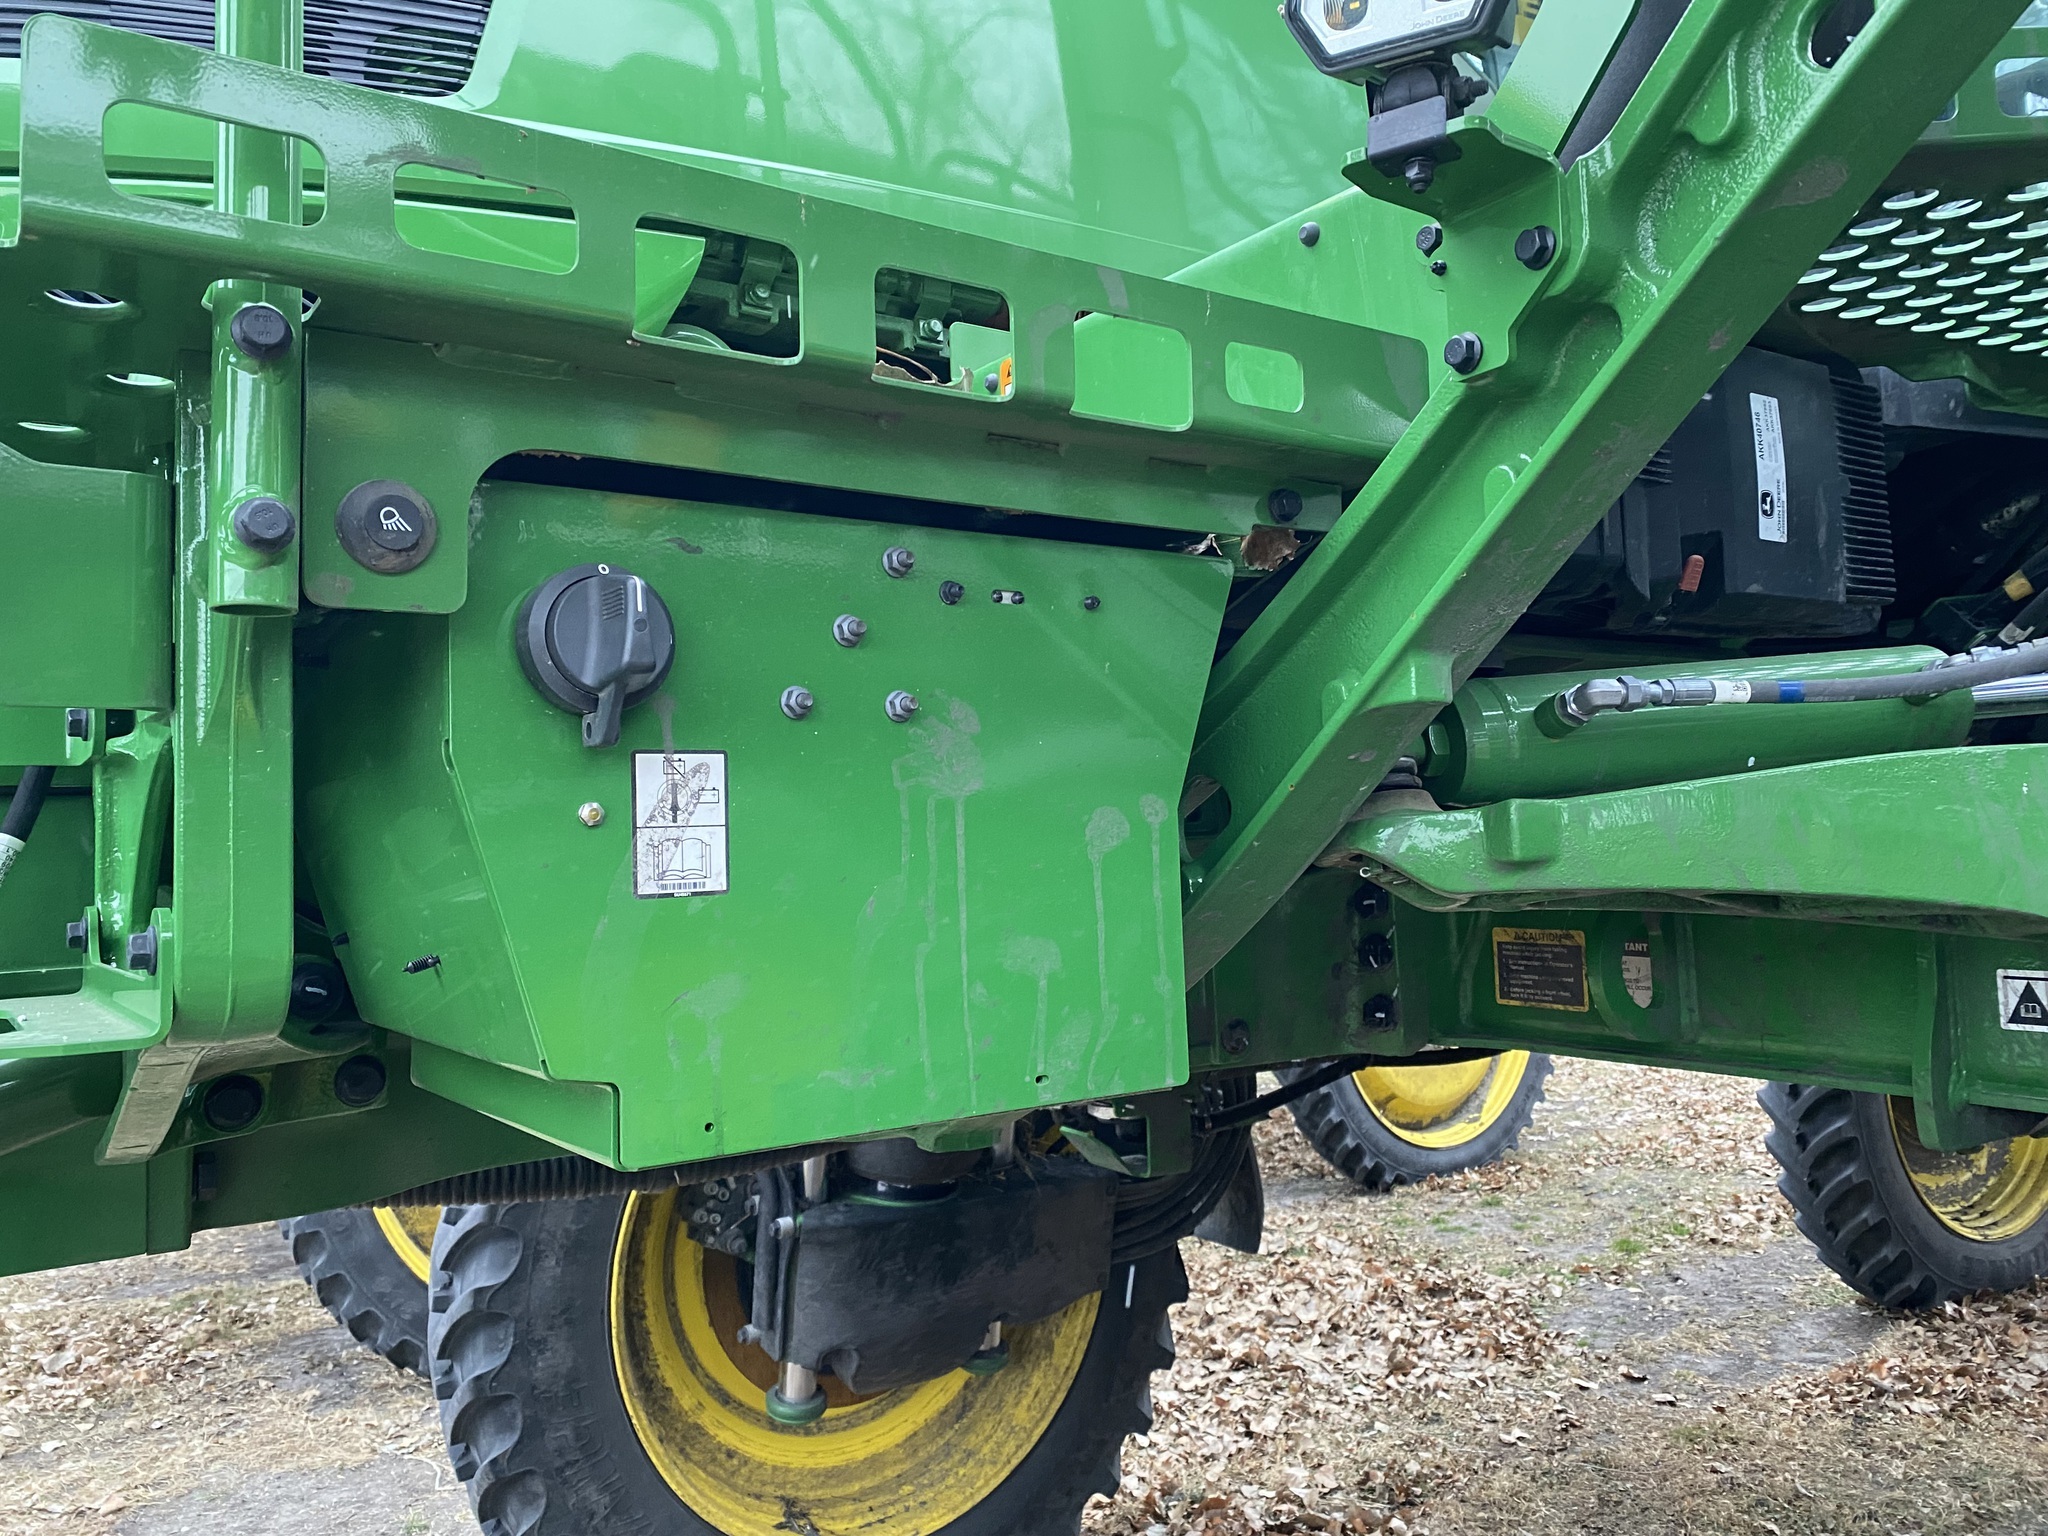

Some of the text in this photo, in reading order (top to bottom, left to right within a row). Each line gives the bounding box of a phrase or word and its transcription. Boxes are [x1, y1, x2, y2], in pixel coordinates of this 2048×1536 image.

[1410, 10, 1465, 30] JOHN DEERE
[1754, 411, 1765, 460] AKK40746
